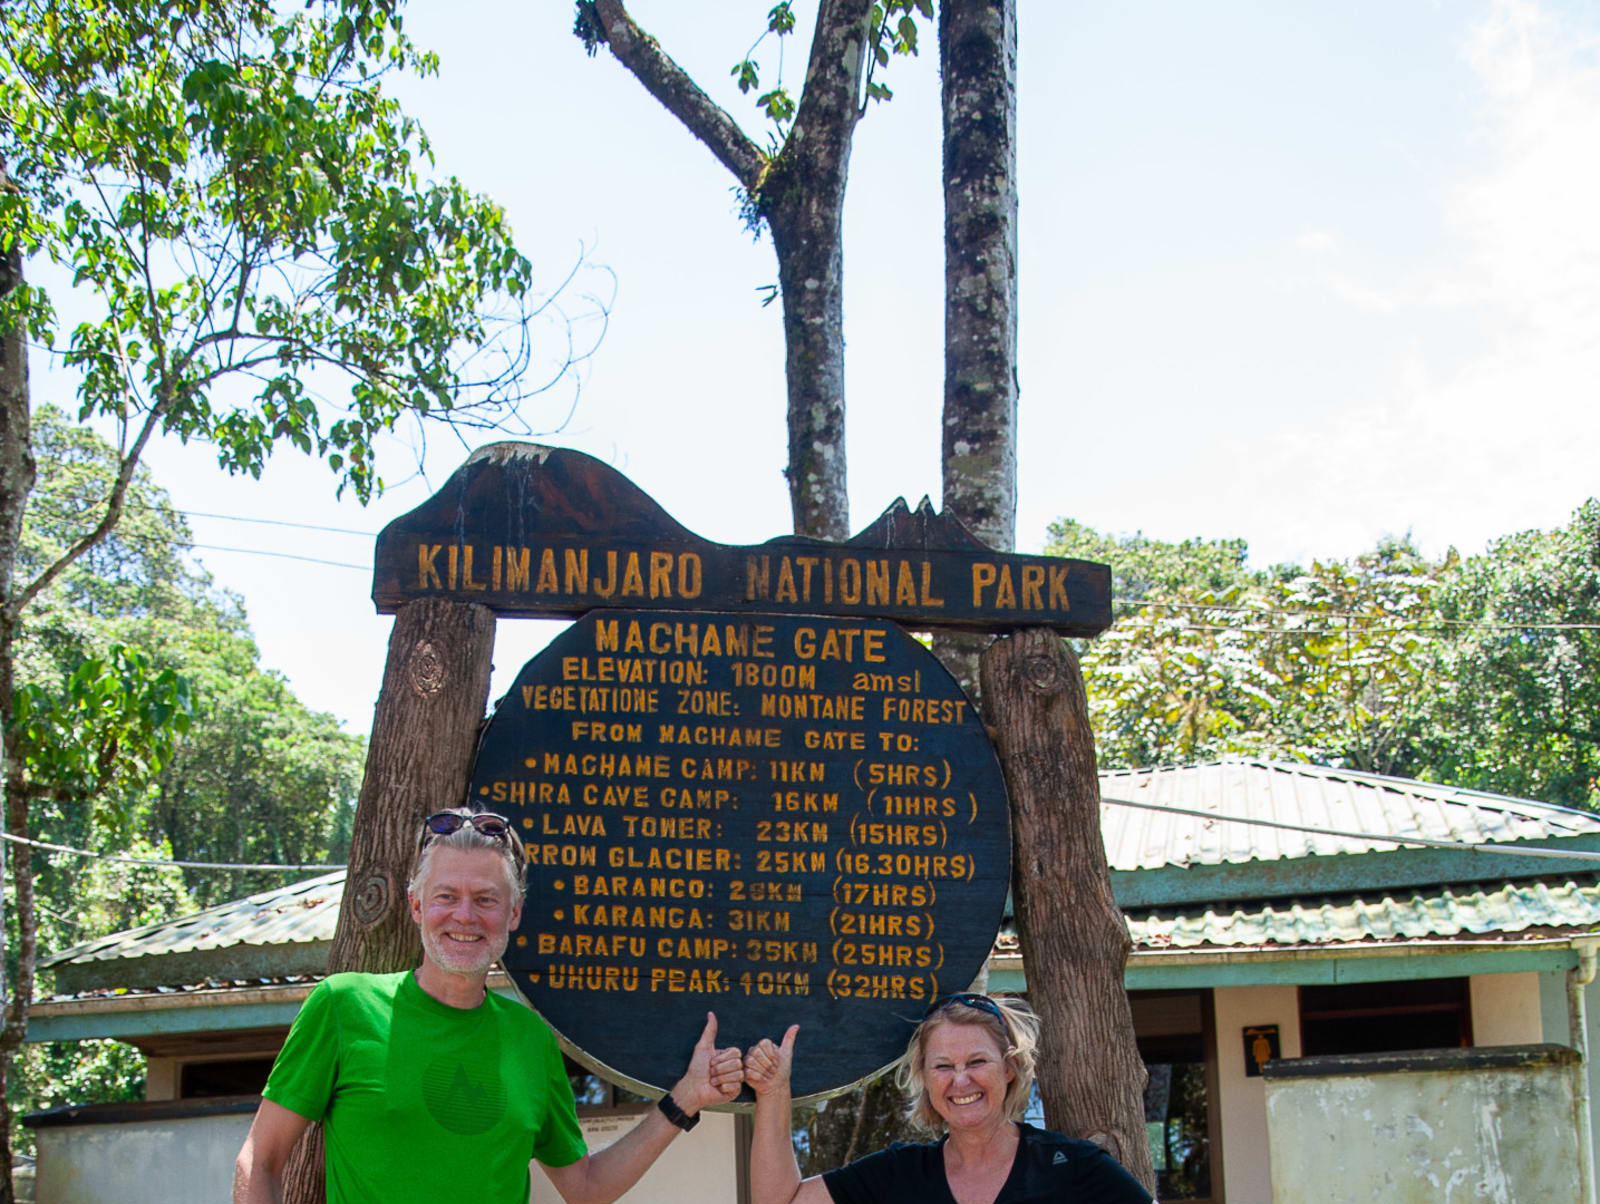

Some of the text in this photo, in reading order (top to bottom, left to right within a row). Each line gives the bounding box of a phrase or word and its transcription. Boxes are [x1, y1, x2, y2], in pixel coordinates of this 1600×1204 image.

[418, 544, 1071, 612] KILIMANJARO NATIONAL PARK
[595, 619, 887, 663] MACHAME GATE
[562, 656, 921, 693] ELEVATION: 1800M amsl
[677, 689, 741, 717] ZONE:
[761, 694, 866, 721] MONTANE
[883, 698, 967, 725] FOREST
[572, 721, 920, 752] FROM MACHAME GATE TO:
[543, 752, 671, 779] MACHAME
[681, 757, 758, 781] CAMP:
[770, 760, 825, 783] 11KM
[492, 781, 571, 806] SHIRA
[583, 784, 650, 808] CAVE
[660, 787, 739, 810] CAMP:
[772, 791, 839, 813] 16KM
[543, 811, 948, 849] LAVA TOWER: 23KM (15HRS)
[525, 843, 976, 884] RROW GLACIER: 25KM (16.30HRS)
[833, 874, 937, 908] (17HRS)
[830, 905, 935, 941] (21HRS)
[537, 934, 945, 970] BARAFU CAMP: 35KM (25HRS)
[548, 964, 940, 1006] UHURU PEAK: 40KM (32HRS)
